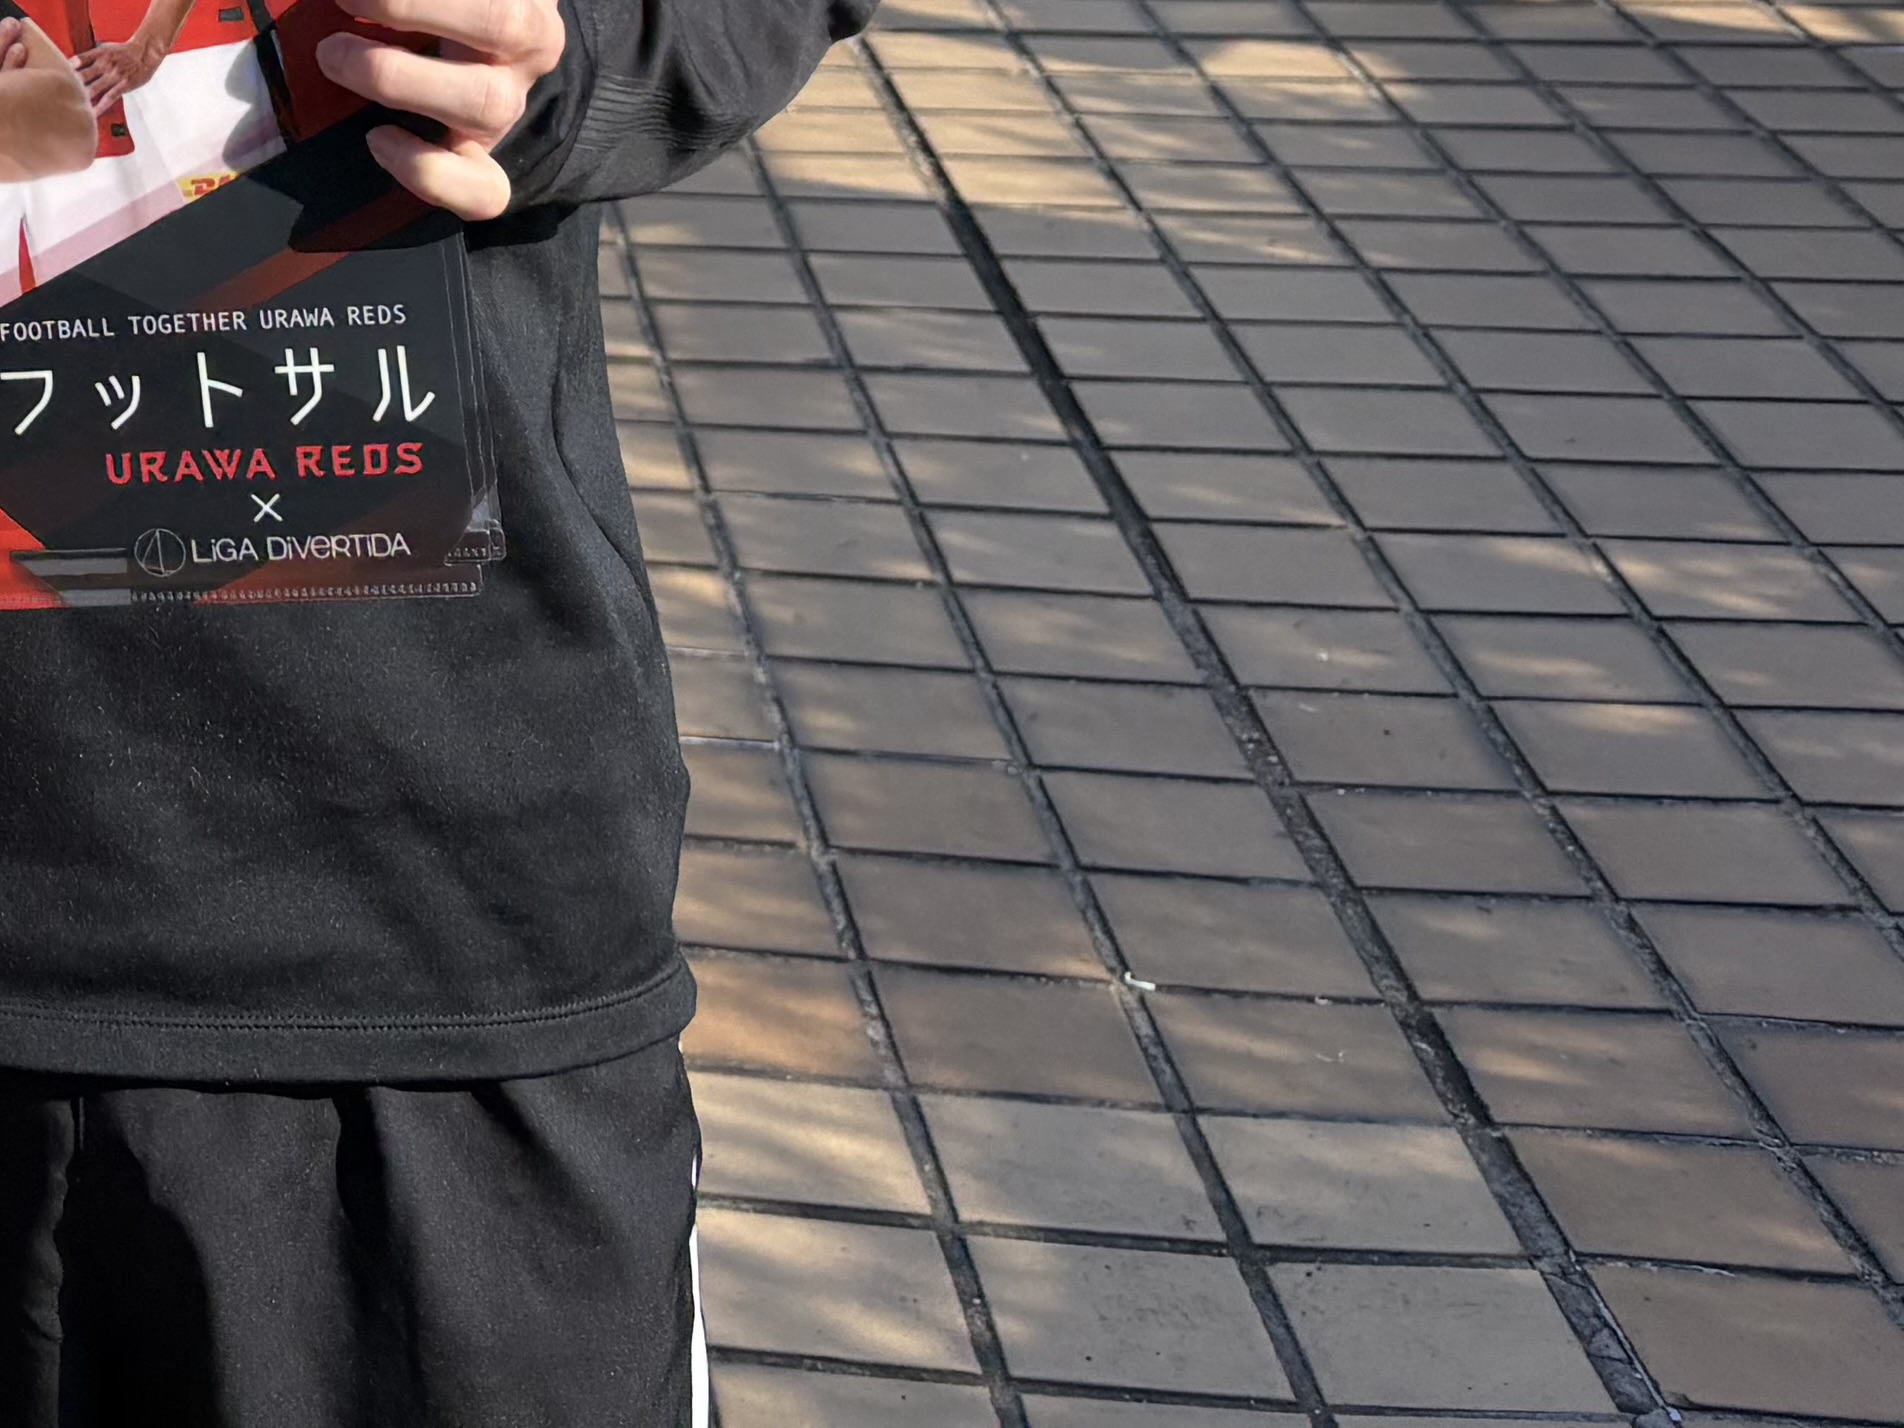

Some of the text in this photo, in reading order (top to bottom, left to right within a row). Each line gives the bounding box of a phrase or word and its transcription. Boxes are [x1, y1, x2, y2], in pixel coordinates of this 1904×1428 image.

[0, 303, 408, 342] FOOTBALL TOGETHER URAWA REDS
[105, 441, 424, 485] URAWA REDS
